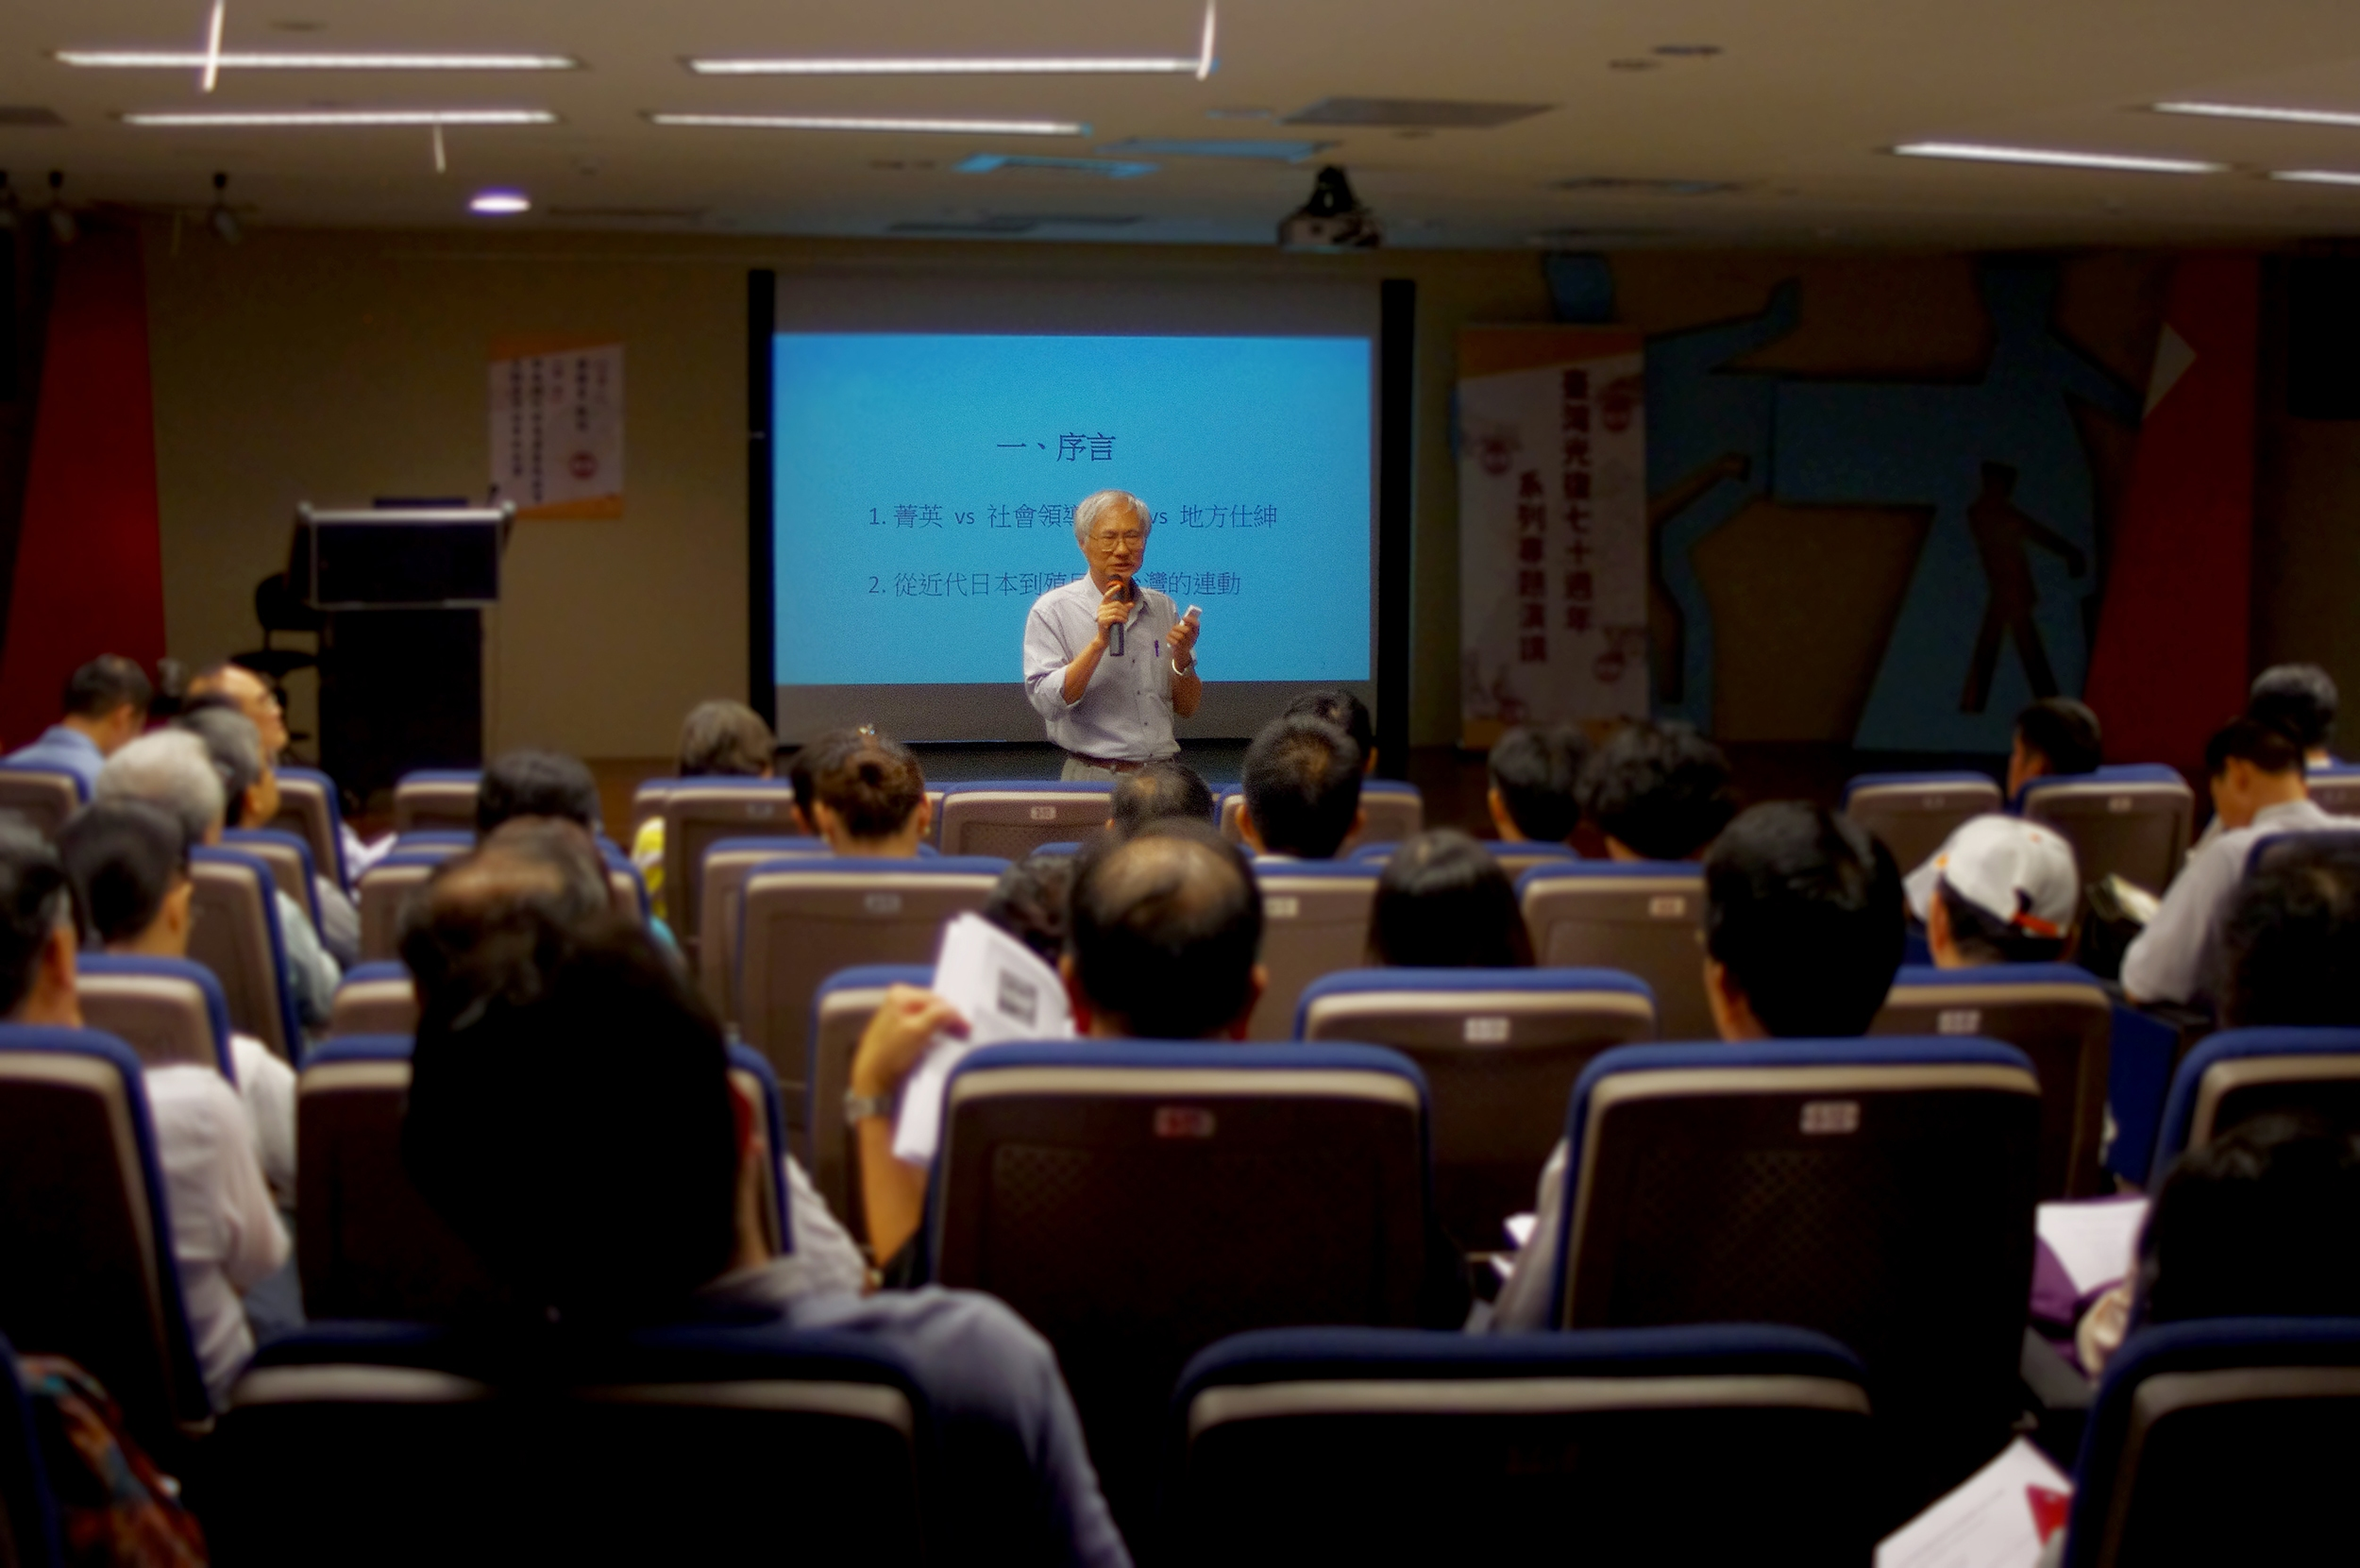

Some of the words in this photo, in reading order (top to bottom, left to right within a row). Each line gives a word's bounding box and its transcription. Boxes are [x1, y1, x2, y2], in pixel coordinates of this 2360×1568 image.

[996, 431, 1117, 463] 一、序言
[868, 507, 886, 525] 1.
[893, 503, 943, 529] 菁英
[954, 512, 975, 525] vs
[1180, 503, 1277, 529] 地方仕紳
[868, 576, 886, 594] 2.
